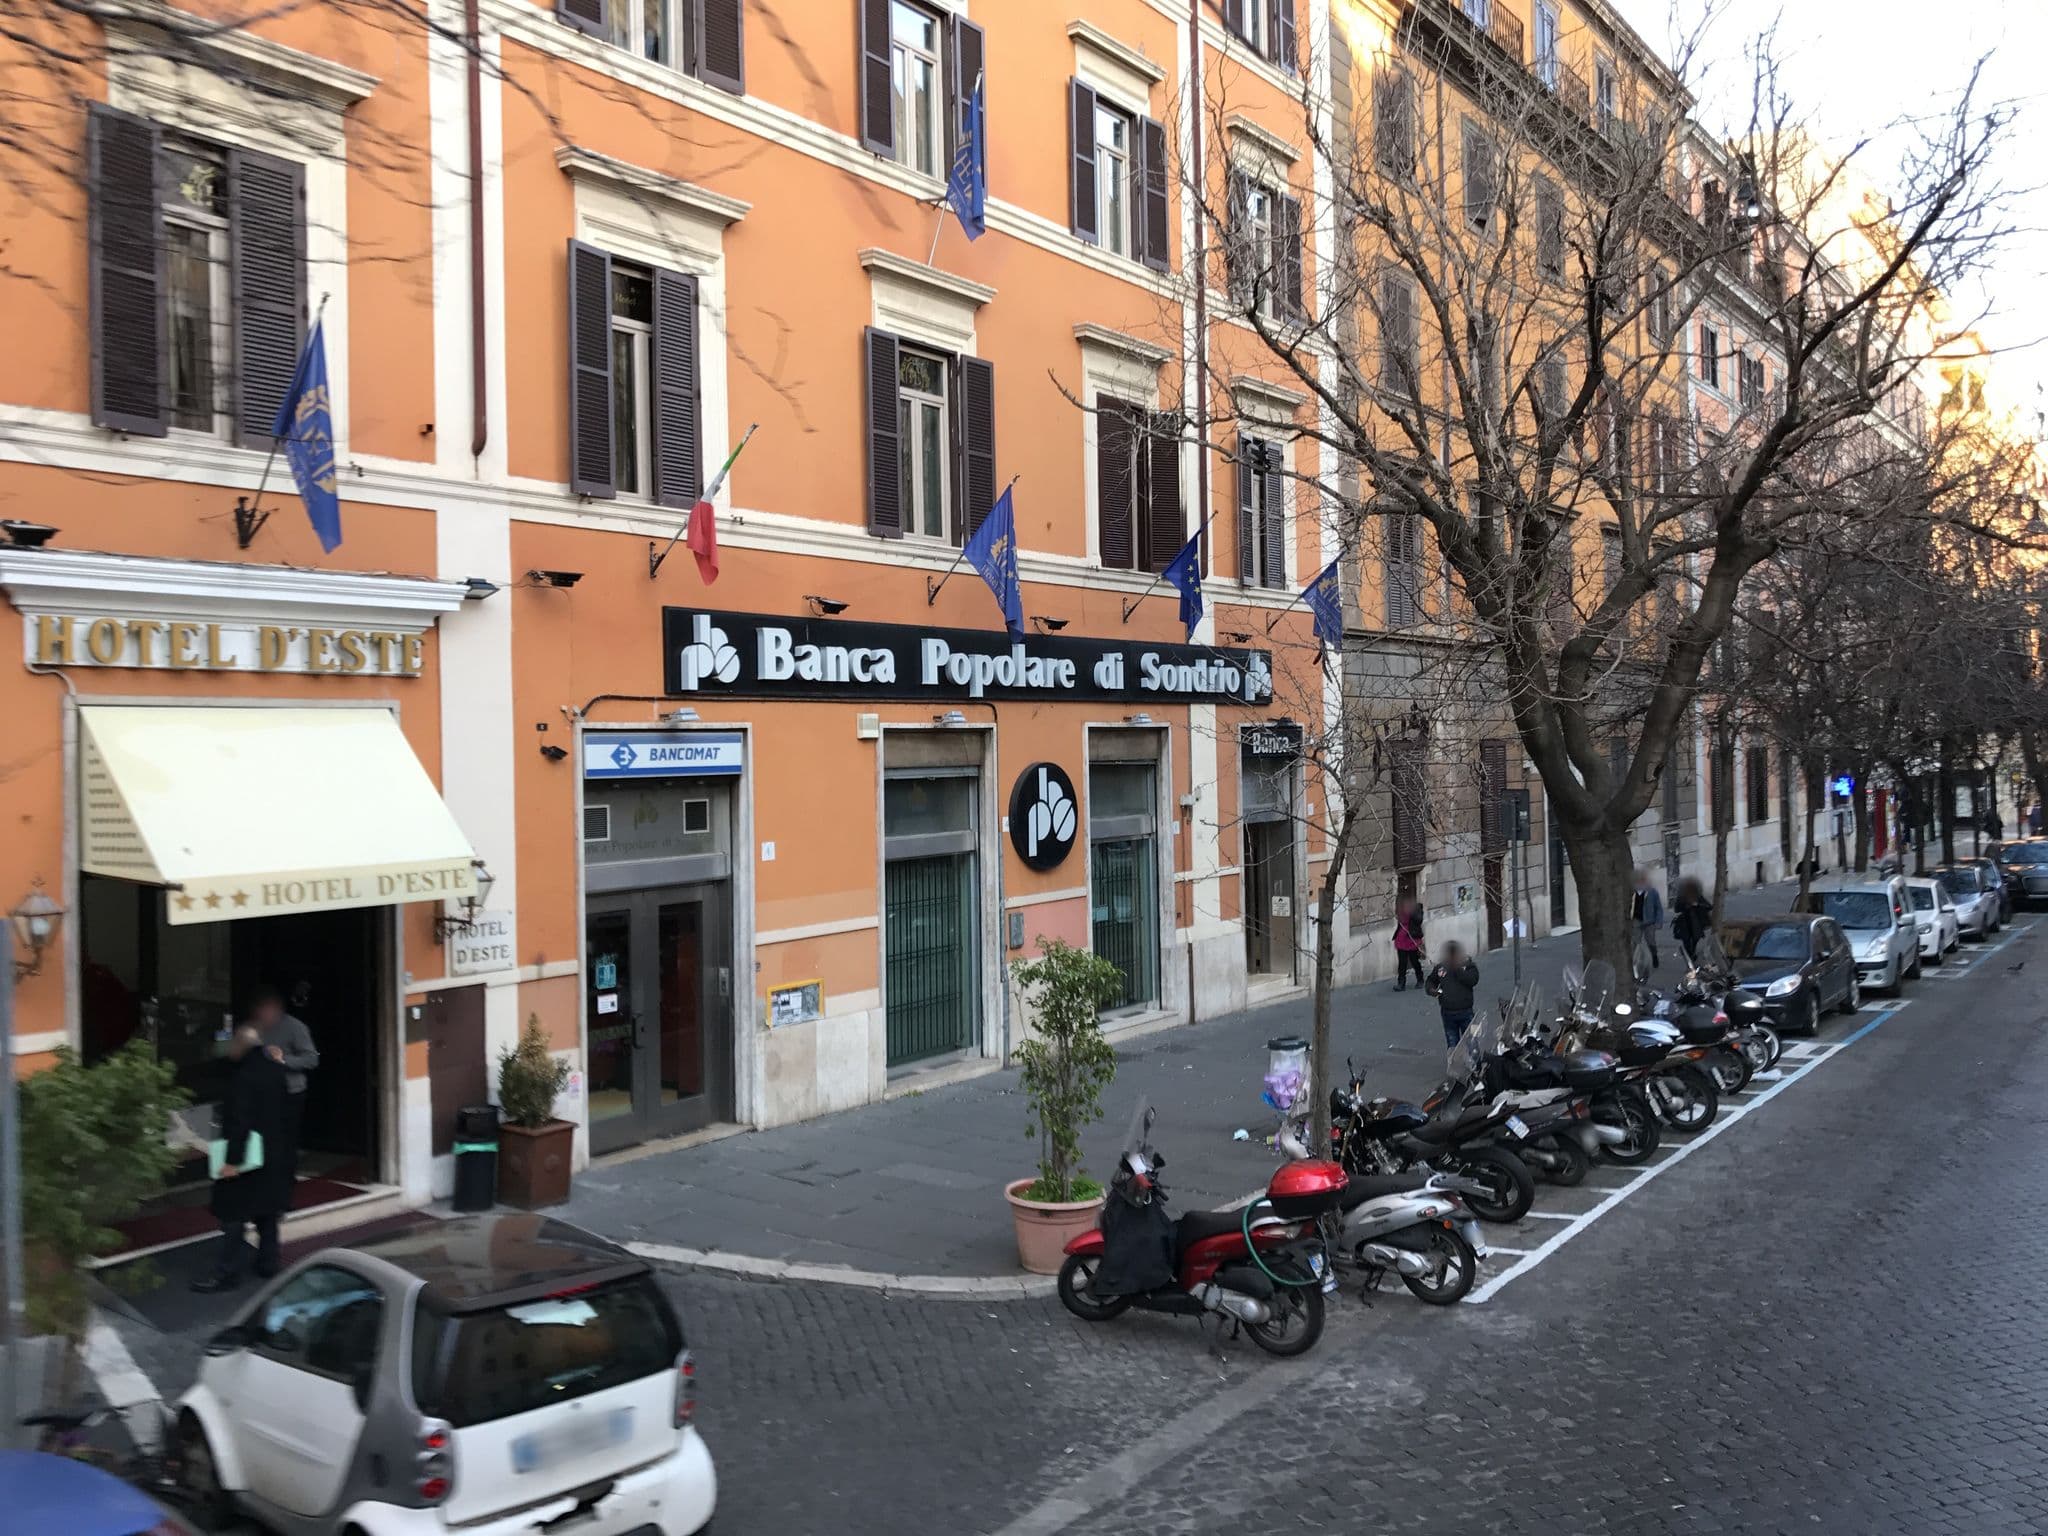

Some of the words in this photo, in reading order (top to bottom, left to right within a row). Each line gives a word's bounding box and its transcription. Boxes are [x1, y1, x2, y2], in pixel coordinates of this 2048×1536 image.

[37, 615, 236, 668] HOTEL
[259, 625, 426, 674] D'ESTE
[756, 627, 896, 683] Banca
[921, 638, 1076, 698] Popolare
[1094, 652, 1125, 690] di
[1140, 652, 1240, 693] Sondrio
[649, 746, 721, 762] BANCOMAT
[262, 876, 361, 906] HOTEL
[377, 867, 469, 896] D'ESTE
[457, 920, 508, 940] HOTEL
